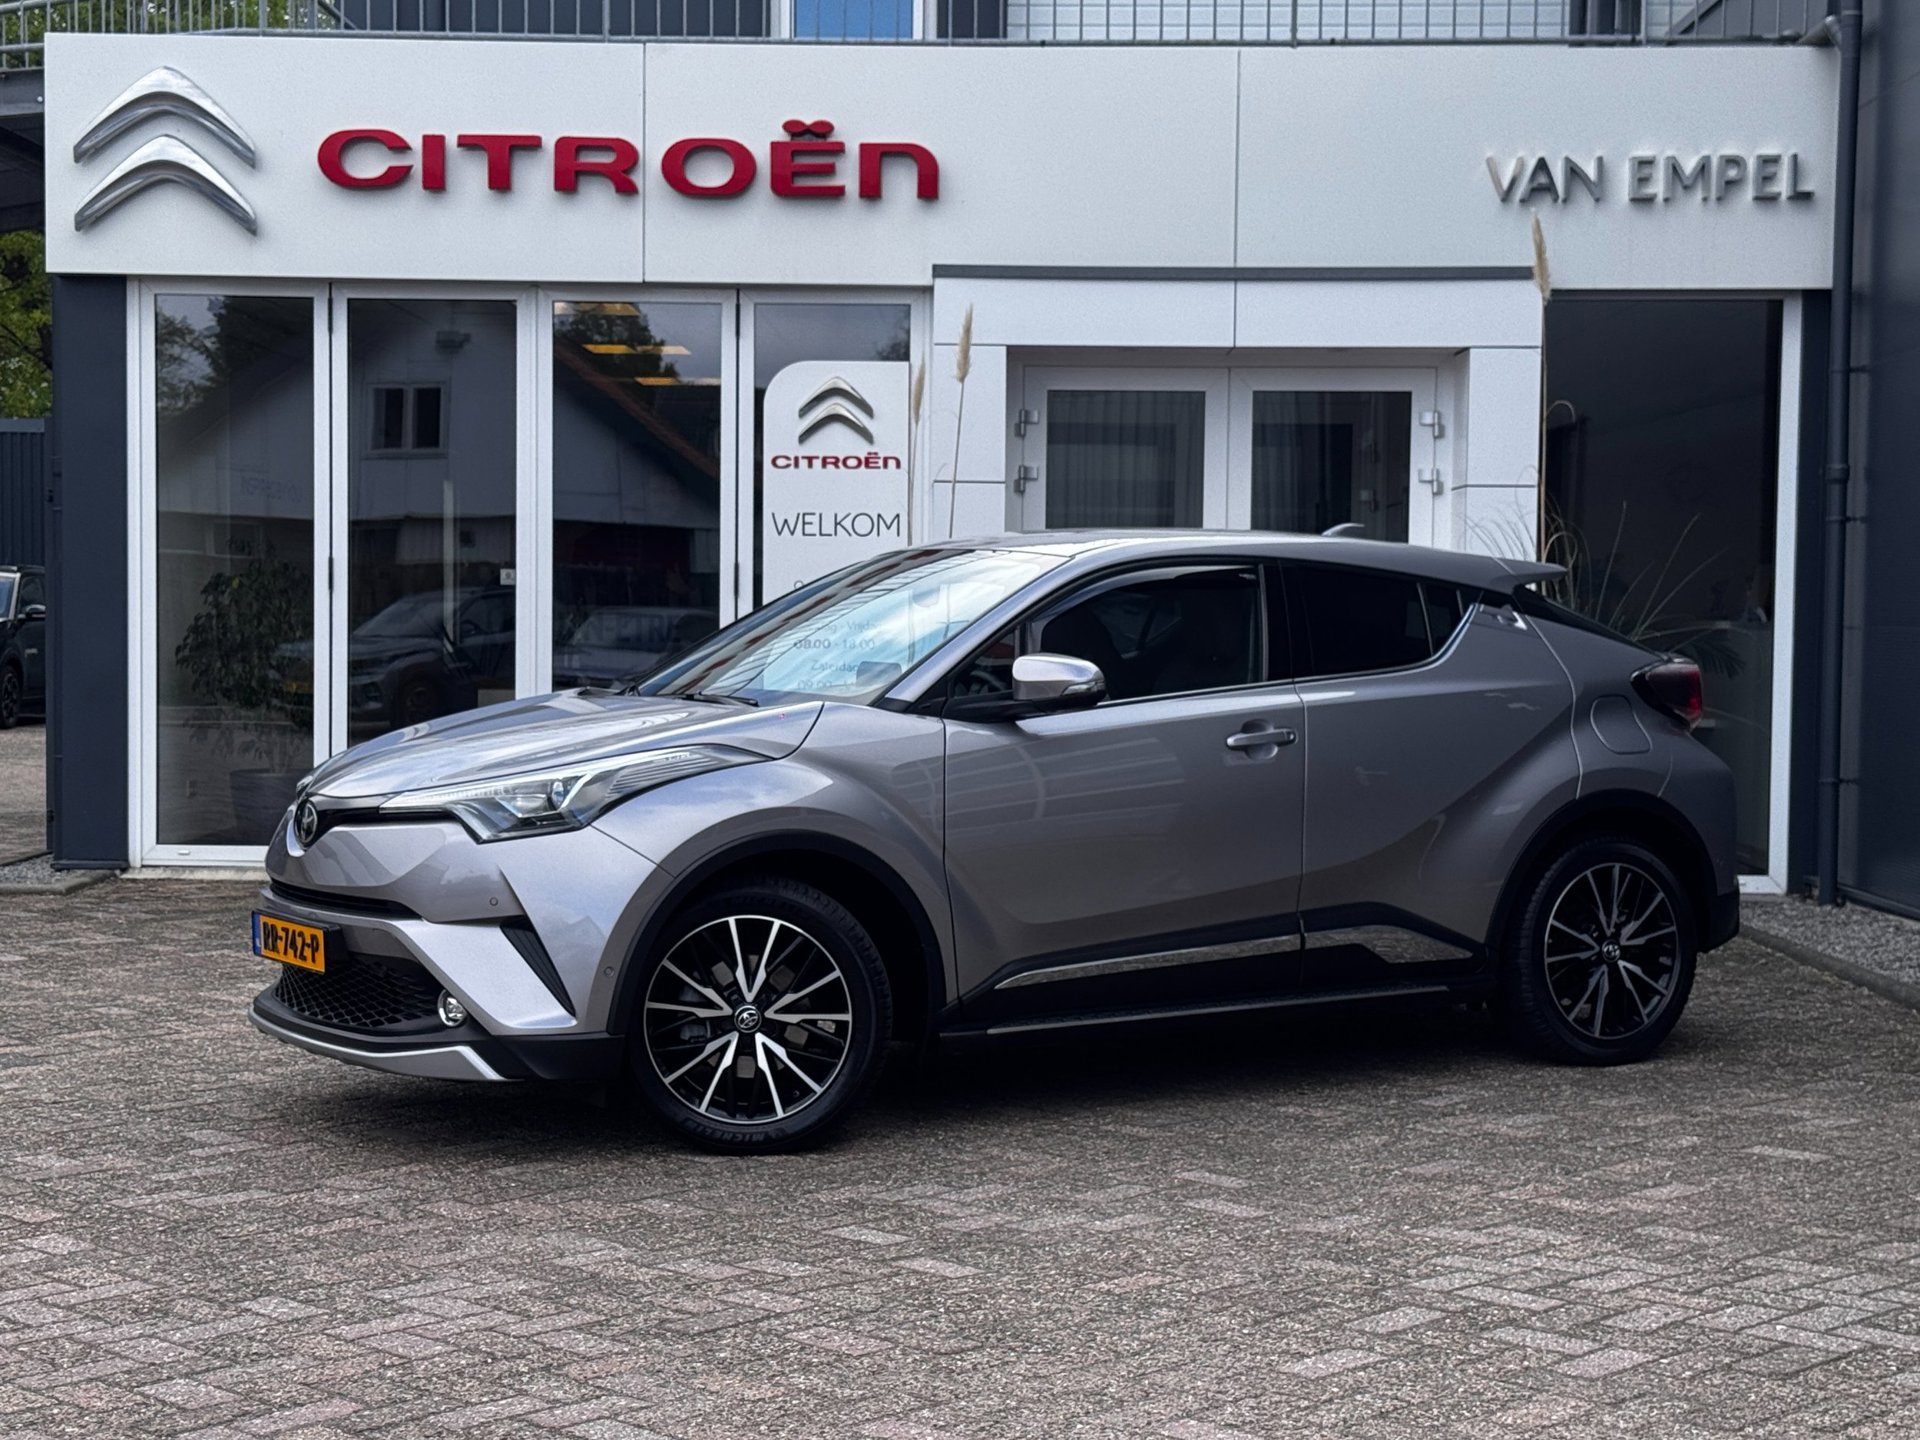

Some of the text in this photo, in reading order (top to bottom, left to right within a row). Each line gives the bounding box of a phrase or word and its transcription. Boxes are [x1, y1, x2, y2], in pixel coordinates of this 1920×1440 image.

[1485, 153, 1815, 204] VAN EMPEL
[771, 512, 901, 537] WELKOM
